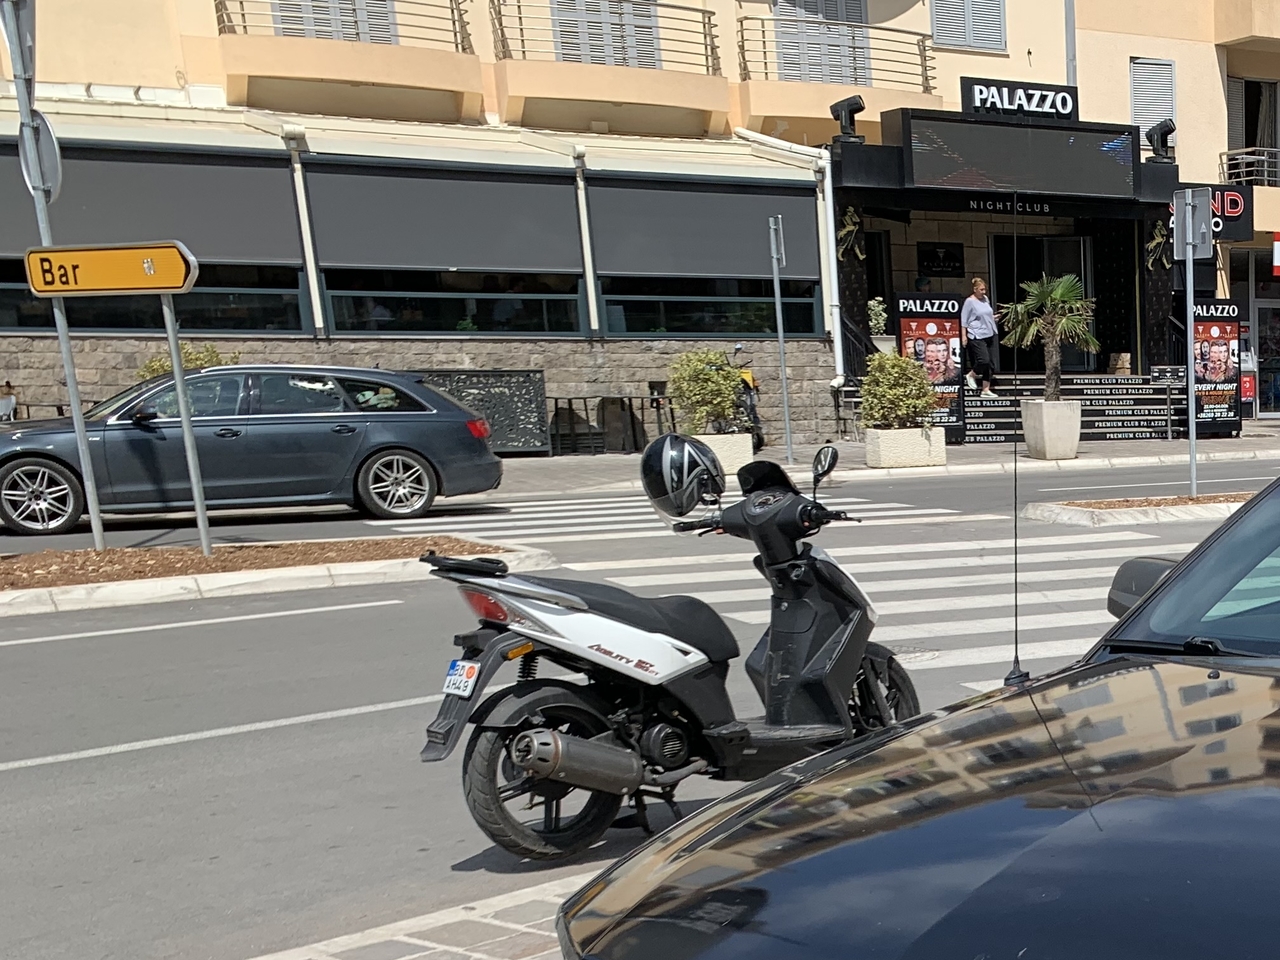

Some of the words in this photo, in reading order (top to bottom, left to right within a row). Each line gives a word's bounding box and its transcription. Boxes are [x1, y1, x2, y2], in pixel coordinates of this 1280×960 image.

[972, 84, 1073, 115] PALAZZO
[969, 200, 1011, 211] NIGHT
[1016, 203, 1050, 213] CLUB
[39, 257, 80, 286] Bar
[899, 299, 960, 313] PALAZZO
[934, 385, 960, 393] NIGHT
[1216, 383, 1238, 391] NIGHT
